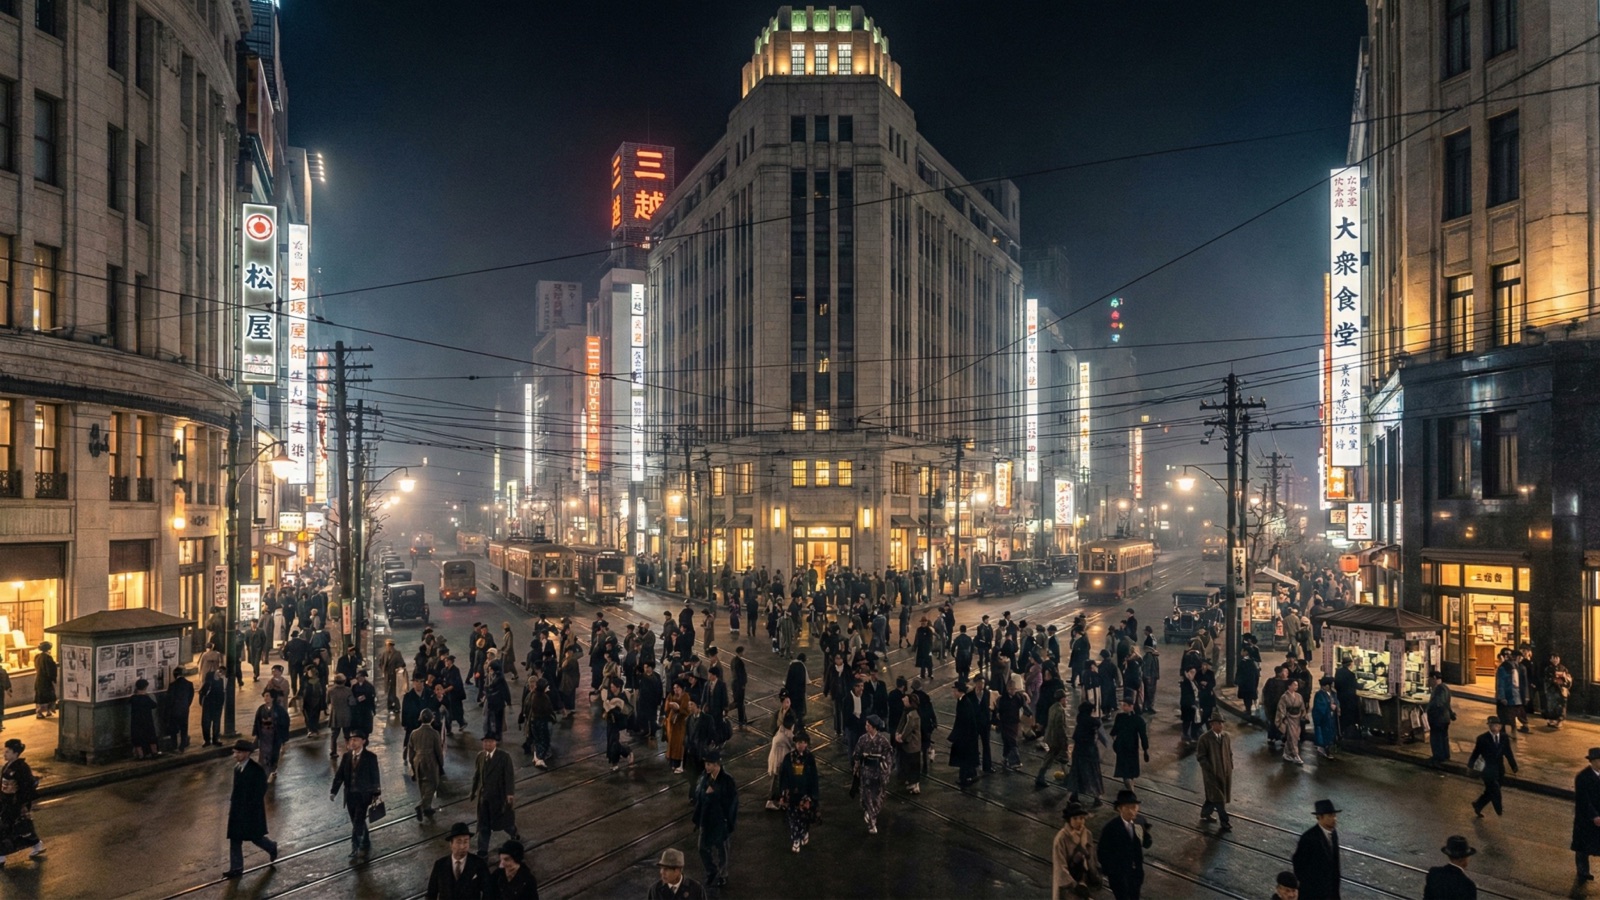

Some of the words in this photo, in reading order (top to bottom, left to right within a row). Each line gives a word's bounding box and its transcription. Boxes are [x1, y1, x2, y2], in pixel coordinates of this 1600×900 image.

[634, 151, 666, 221] 三越
[245, 263, 274, 341] 松屋
[1333, 217, 1359, 348] 大衆食堂
